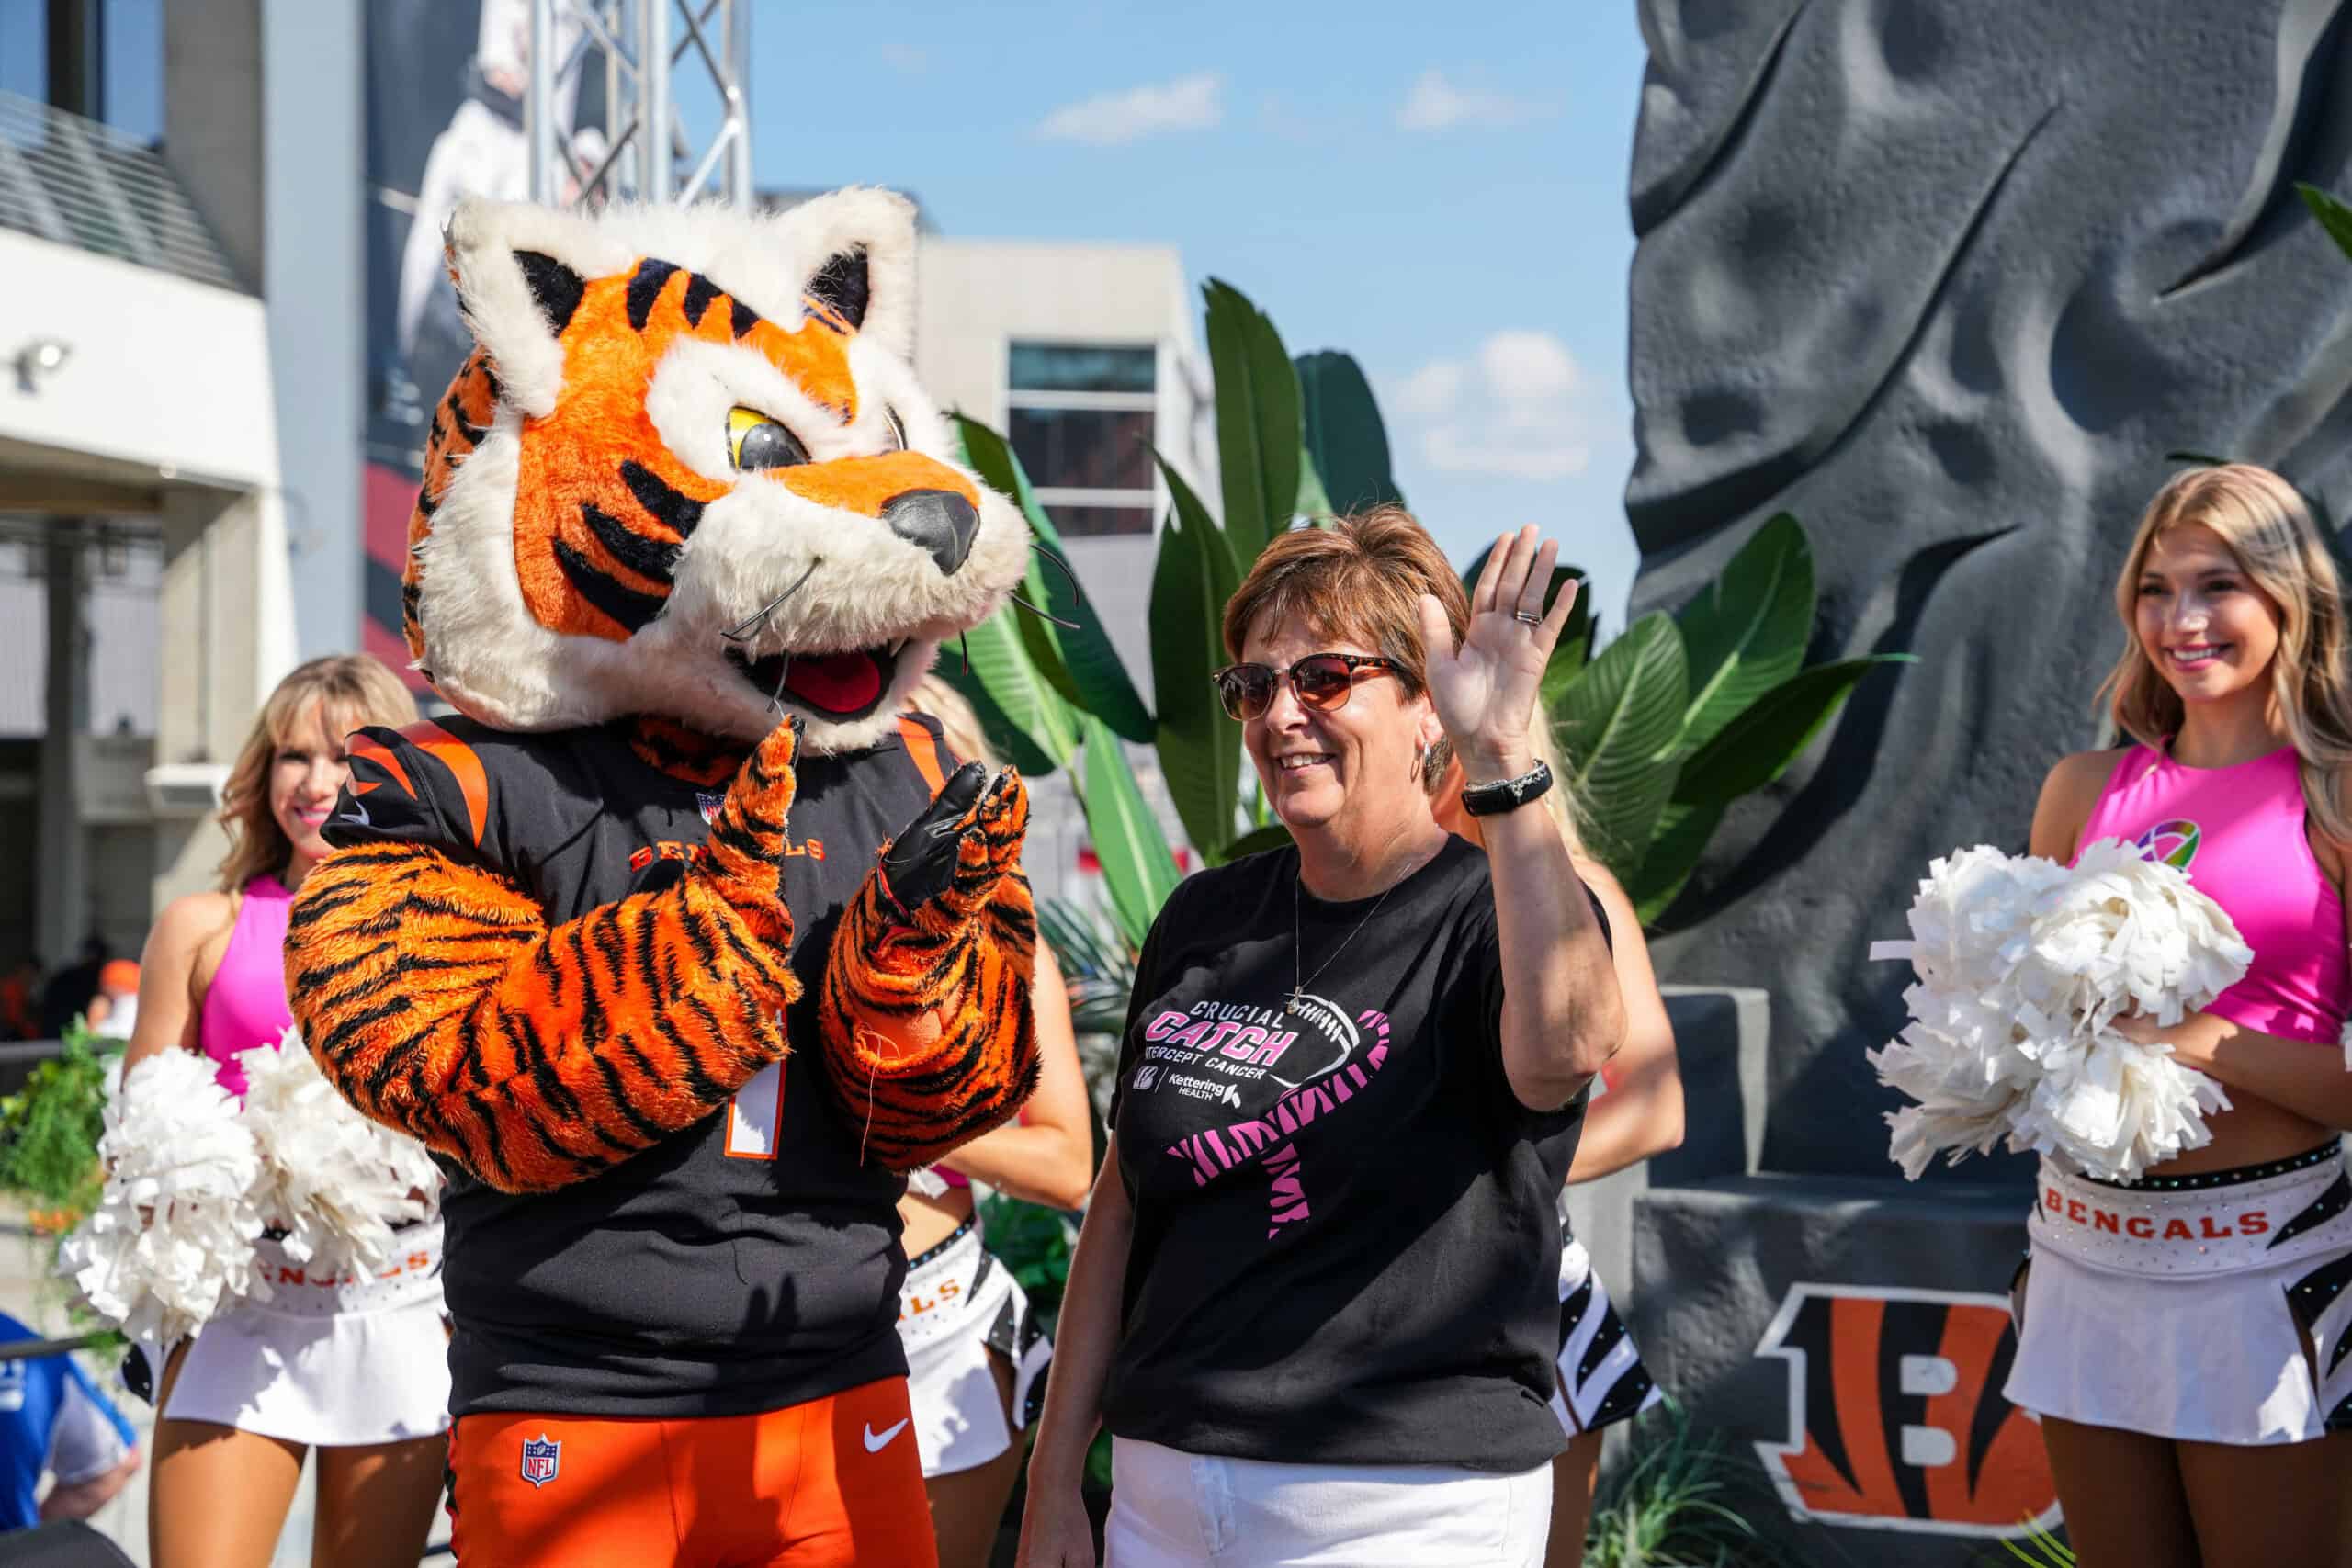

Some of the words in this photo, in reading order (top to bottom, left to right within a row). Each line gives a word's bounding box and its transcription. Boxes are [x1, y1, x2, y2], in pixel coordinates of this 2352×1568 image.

[1190, 1000, 1284, 1029] CRUCIAL
[1145, 1010, 1300, 1067] CATCH
[1205, 1057, 1267, 1080] CANCER
[1169, 1073, 1226, 1097] Kettering
[1178, 1087, 1214, 1101] HEALTH
[2045, 1188, 2269, 1240] BENGALS
[527, 1457, 552, 1478] NFL
